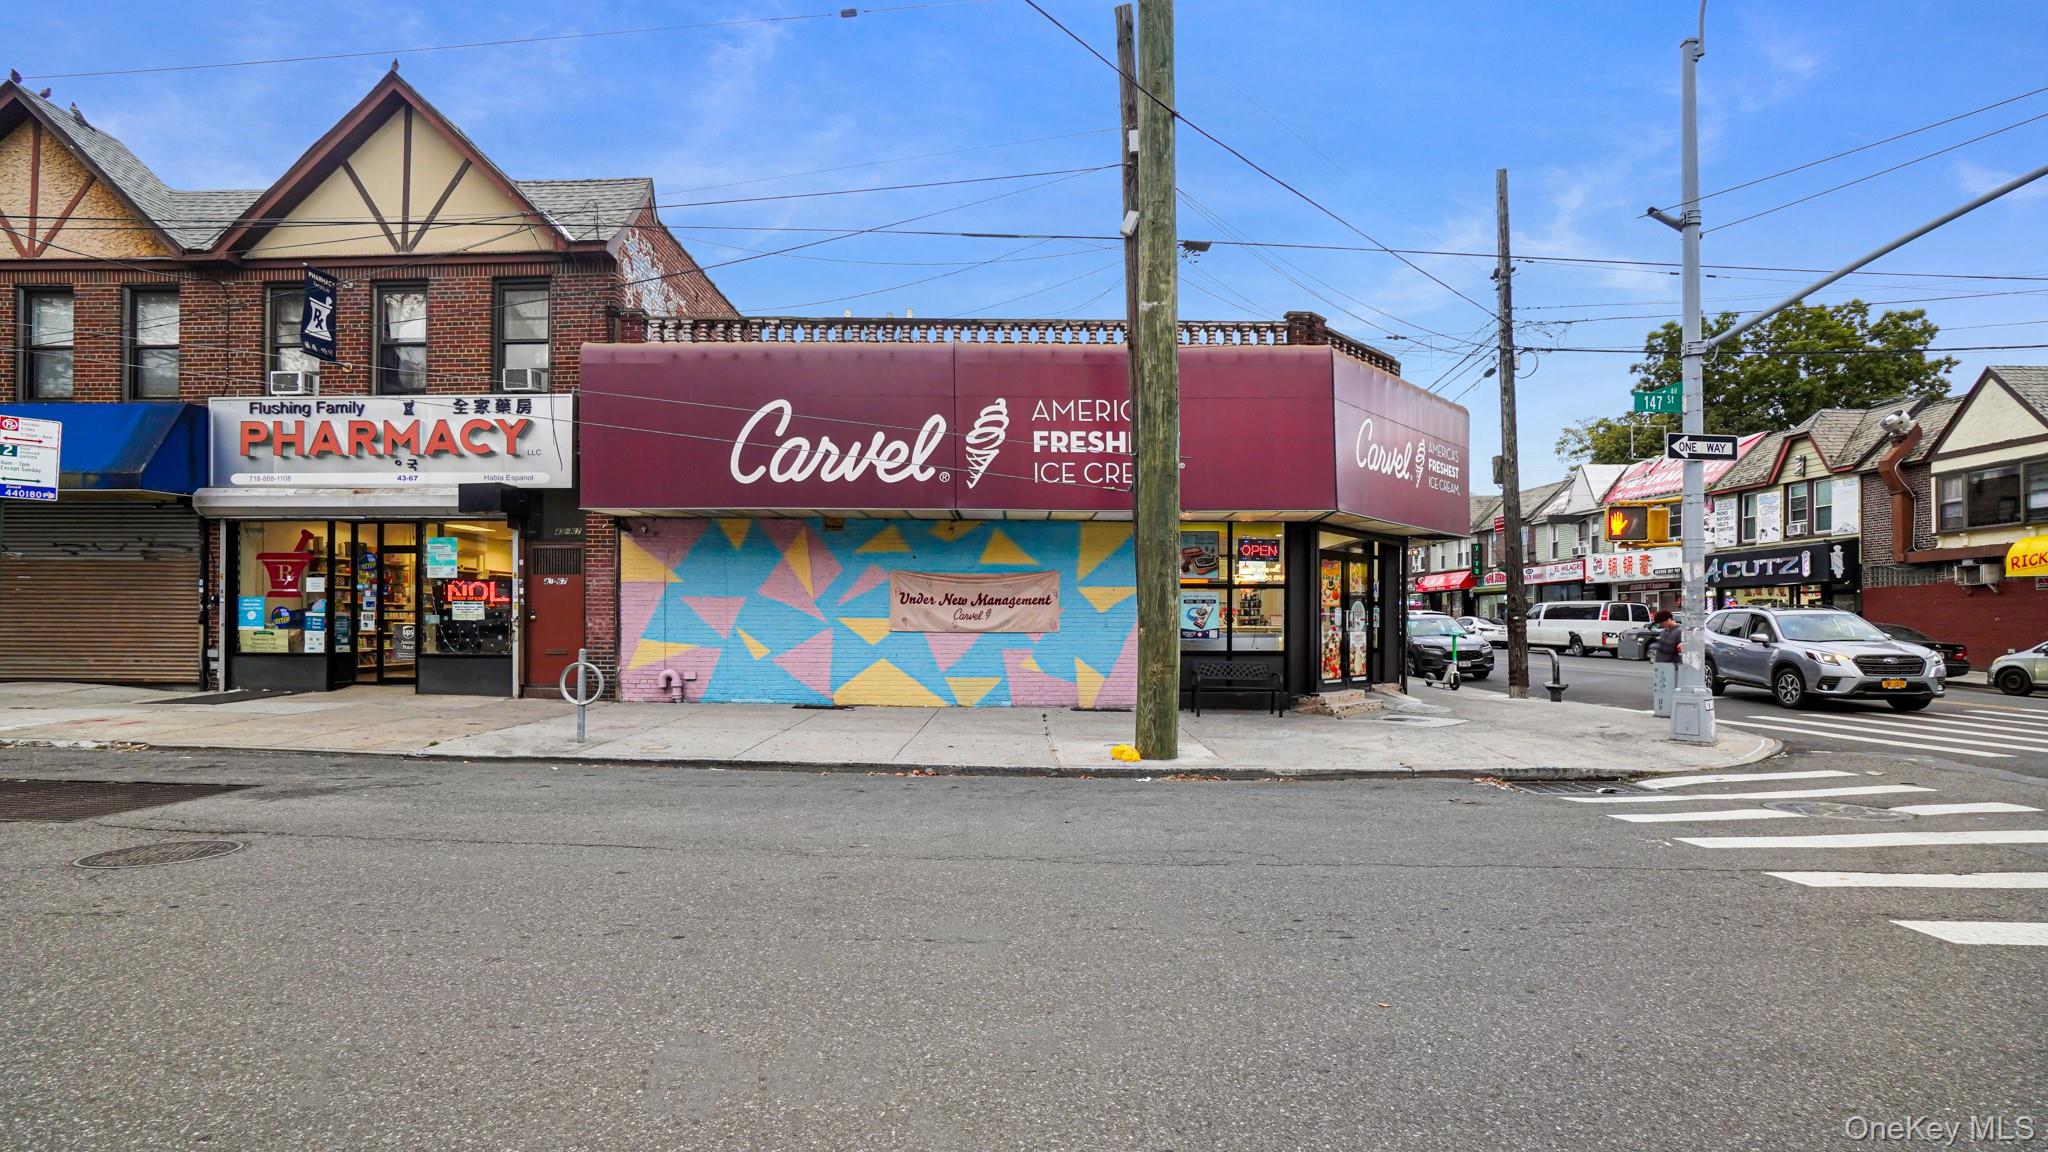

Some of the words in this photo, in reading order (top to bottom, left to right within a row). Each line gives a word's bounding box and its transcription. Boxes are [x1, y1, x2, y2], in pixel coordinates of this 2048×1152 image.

[308, 272, 335, 287] PHARMACY
[249, 402, 312, 418] Flushing
[316, 401, 366, 417] Family
[452, 398, 532, 414] 全家藥房
[1644, 395, 1662, 410] 147
[1032, 400, 1131, 422] AMERIC
[240, 418, 529, 457] PHARMACY
[730, 398, 947, 484] Carvel
[1033, 431, 1132, 452] FRESH
[3, 445, 12, 456] 2
[1356, 418, 1412, 480] Carvel
[1679, 442, 1698, 453] ONE
[1706, 443, 1726, 453] WAY
[1034, 462, 1076, 484] ICE
[1084, 462, 1132, 484] CRE
[1428, 458, 1460, 479] FRESHEST
[5, 488, 41, 498] 440180
[1428, 476, 1438, 490] ICE
[1439, 478, 1460, 494] CREAM
[1242, 544, 1278, 556] OPEN
[1561, 562, 1582, 571] MILAGRO
[899, 592, 936, 606] Under
[938, 593, 968, 606] New
[971, 593, 1052, 608] Management
[954, 608, 984, 620] Carvel
